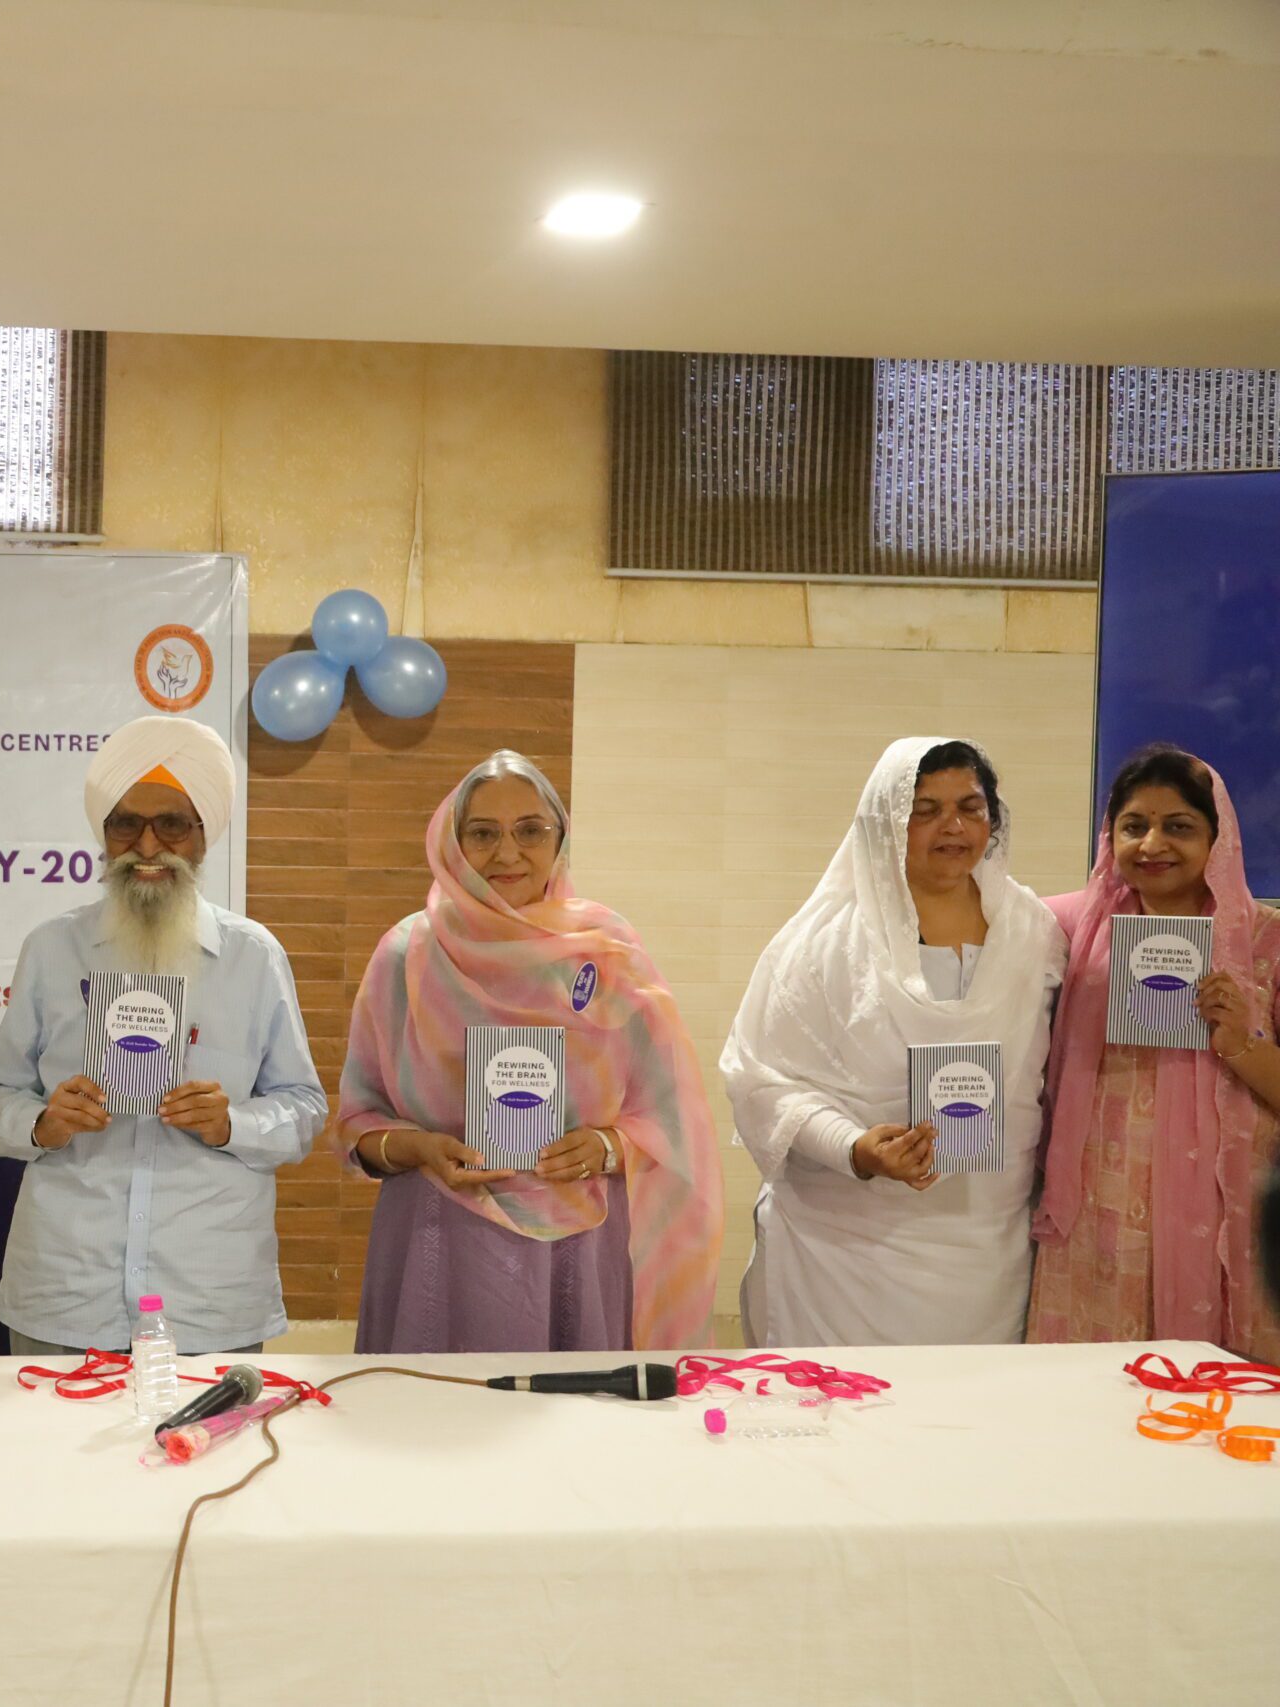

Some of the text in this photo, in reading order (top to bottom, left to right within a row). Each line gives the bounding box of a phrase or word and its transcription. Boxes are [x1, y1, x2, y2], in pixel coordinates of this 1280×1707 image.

[1142, 947, 1191, 957] REWIRING
[1140, 956, 1193, 965] THE BRAIN
[1153, 964, 1196, 973] WELLNESS
[118, 1004, 165, 1015] REWIRING
[116, 1013, 166, 1025] THE BRAIN
[111, 1022, 169, 1033] FOR WELLNESS
[497, 1061, 545, 1070] REWIRING
[495, 1070, 547, 1080] THE BRAIN
[939, 1075, 984, 1083] REWIRING
[509, 1080, 551, 1088] WELLNESS
